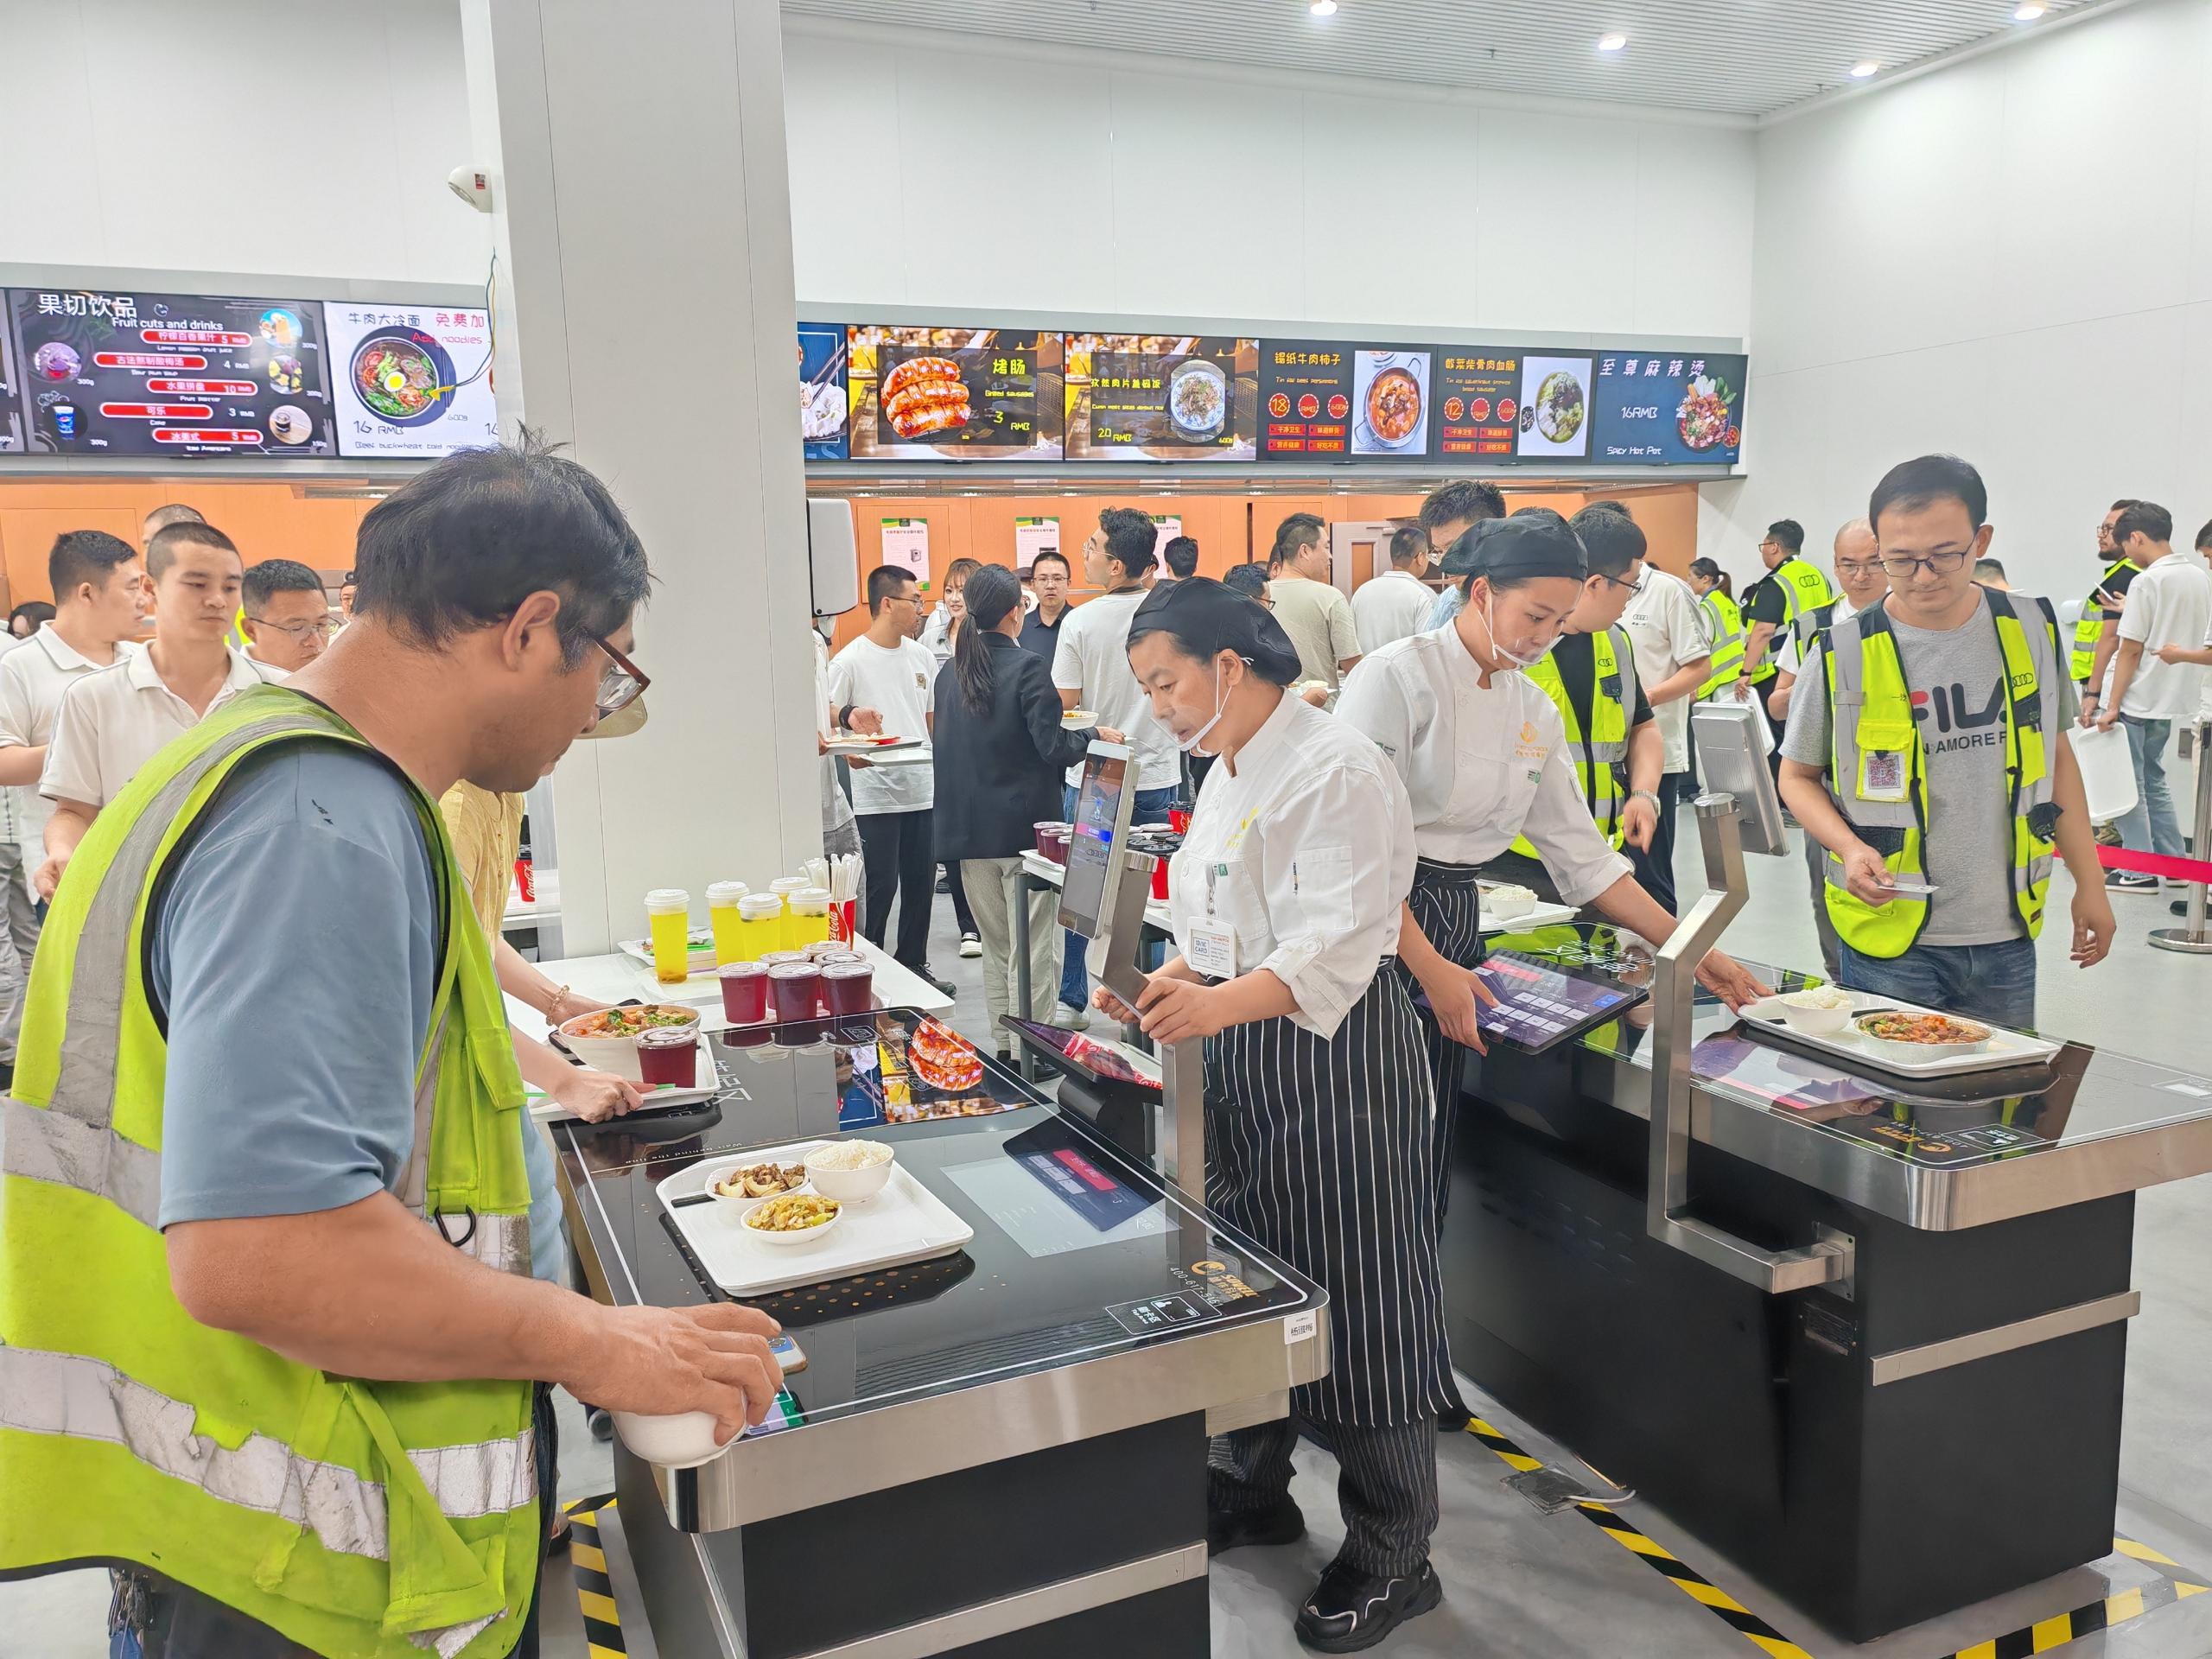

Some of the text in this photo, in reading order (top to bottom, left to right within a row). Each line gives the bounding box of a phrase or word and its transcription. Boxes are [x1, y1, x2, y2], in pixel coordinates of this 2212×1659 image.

[38, 293, 137, 318] 果切饮品
[112, 317, 224, 331] Fruit cuts and drinks
[348, 312, 421, 327] 牛肉大冷面
[221, 335, 228, 344] 5
[442, 335, 483, 345] noodles
[224, 360, 232, 369] 4
[1274, 353, 1341, 366] 锡纸牛肉柿子
[993, 359, 1026, 375] 烤肠
[1599, 359, 1705, 378] 至尊麻辣烫
[224, 385, 236, 394] 10
[145, 406, 166, 416] 可乐
[228, 408, 236, 417] 3
[1272, 398, 1287, 413] 18
[1447, 402, 1459, 416] 12
[994, 410, 1003, 423] 3
[1621, 407, 1658, 419] 16RMB
[353, 420, 404, 435] 16 RMB
[1010, 422, 1030, 430] RMB
[231, 432, 238, 441] 5
[1097, 429, 1132, 442] 20 RMB
[1606, 446, 1627, 455] Spicy
[1646, 446, 1662, 455] Pot
[1936, 732, 1996, 755] AMORE
